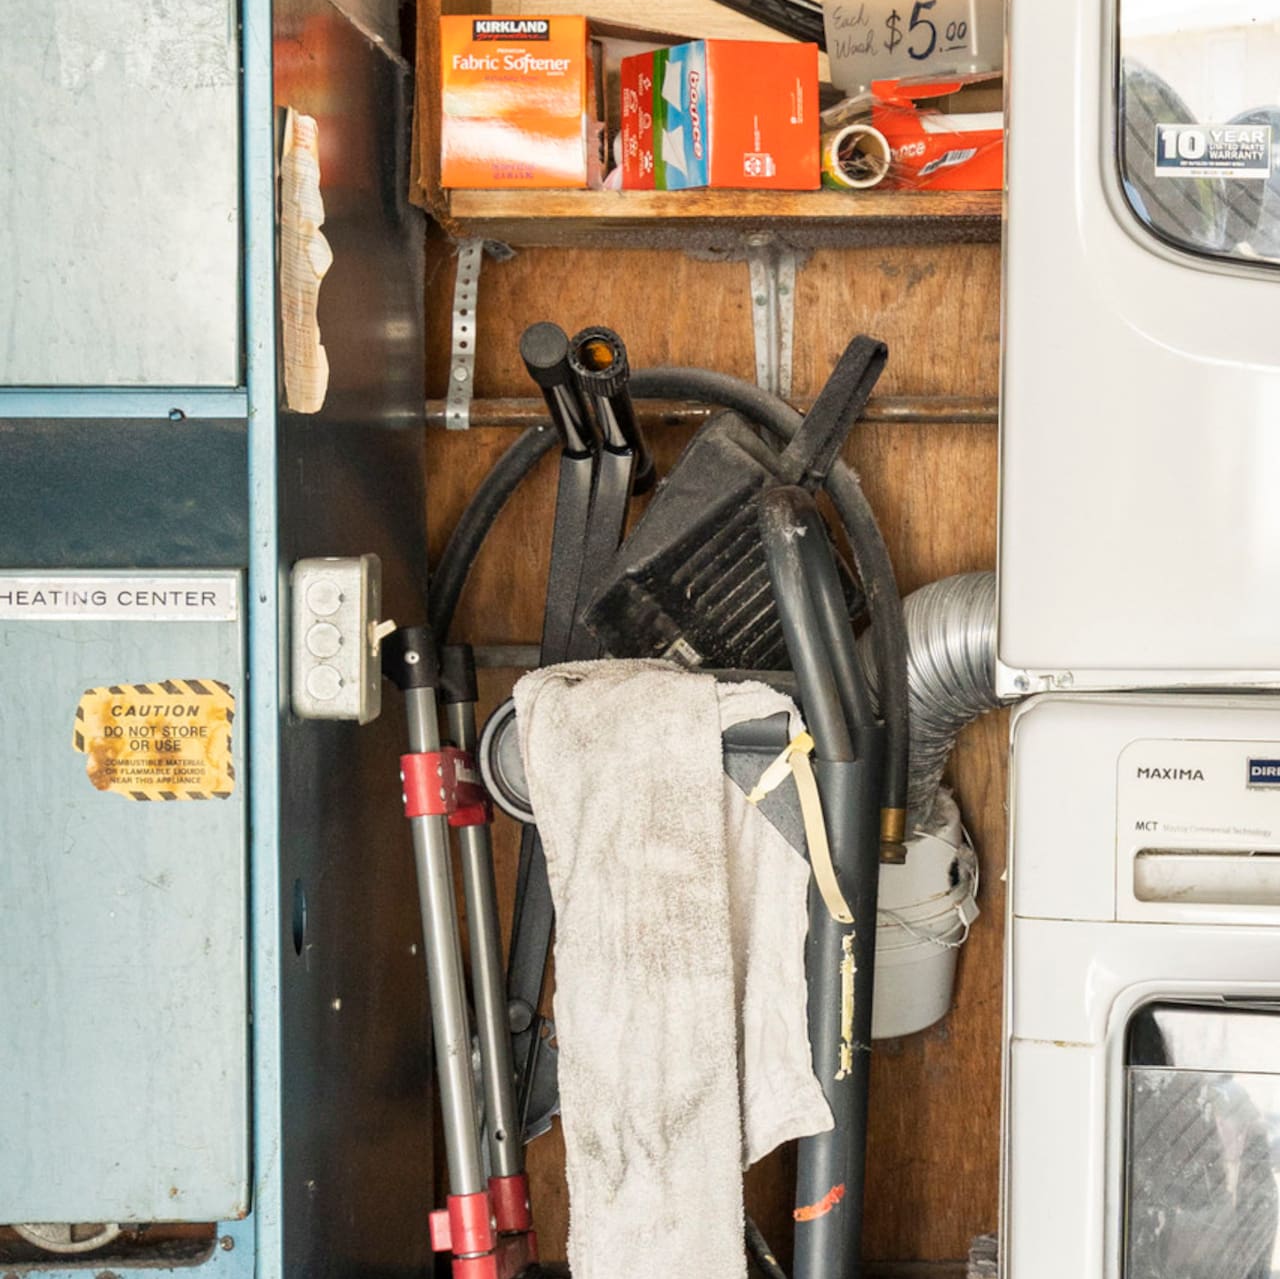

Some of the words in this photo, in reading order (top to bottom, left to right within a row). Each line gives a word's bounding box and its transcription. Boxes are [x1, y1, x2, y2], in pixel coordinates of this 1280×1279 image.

[832, 3, 869, 30] Each
[475, 21, 548, 33] KIRKLAND
[884, 0, 968, 61] $5.00
[452, 54, 499, 70] Fabric
[503, 53, 571, 74] Softener
[689, 70, 703, 160] bounce
[1162, 128, 1206, 160] 10
[1209, 129, 1265, 143] YEAR
[1209, 150, 1265, 161] WARRANTY
[0, 591, 107, 606] HEATING
[117, 591, 217, 606] CENTER
[111, 705, 200, 717] CAUTION
[104, 726, 124, 737] DO
[129, 726, 157, 737] NOT
[162, 726, 208, 737] STORE
[130, 740, 150, 751] OR
[155, 740, 181, 751] USE
[105, 759, 163, 767] COMBUSTIBLE
[166, 759, 205, 767] MATERIAL
[1136, 767, 1205, 781] MAXIMA
[1135, 820, 1158, 831] MCT
